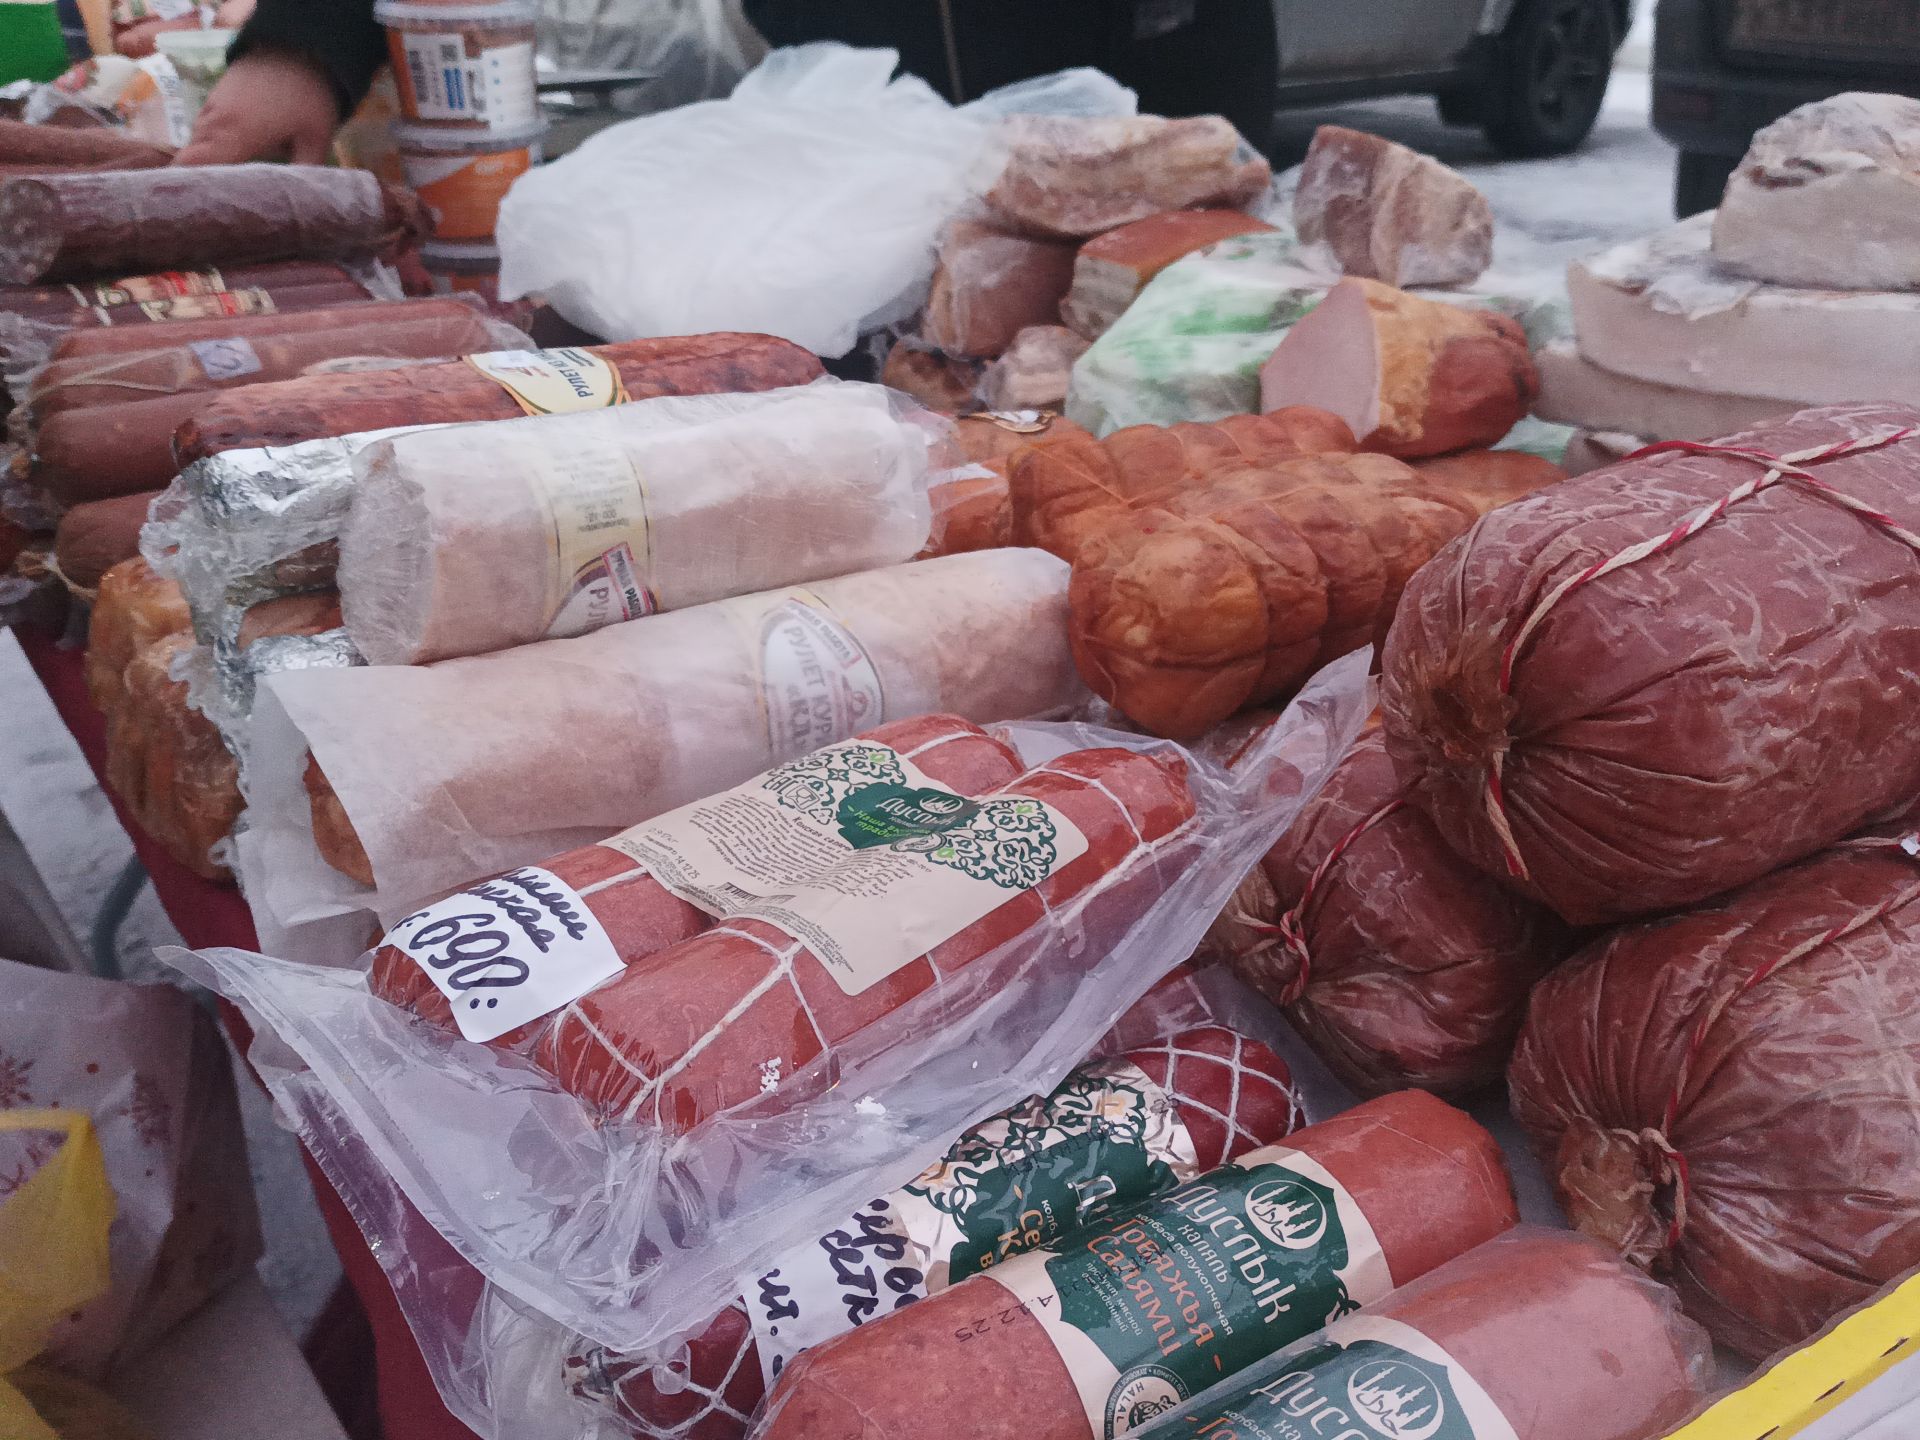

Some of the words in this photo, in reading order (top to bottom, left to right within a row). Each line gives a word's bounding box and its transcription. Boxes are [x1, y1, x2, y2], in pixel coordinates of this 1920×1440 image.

[1019, 1209, 1045, 1248] Се
[1041, 1199, 1059, 1233] колб
[818, 1229, 877, 1326] сетк
[1111, 1217, 1216, 1348] Говяжья
[1135, 1213, 1176, 1243] колбаса
[1173, 1242, 1235, 1337] полукопченая
[1160, 1185, 1297, 1325] Дуслык
[1176, 1224, 1228, 1284] халяль
[1087, 1234, 1183, 1358] Салями
[1114, 1296, 1143, 1338] мясной
[1115, 1380, 1146, 1424] HALAL
[1249, 1370, 1369, 1440] Дус
[1273, 1418, 1303, 1440] ха
